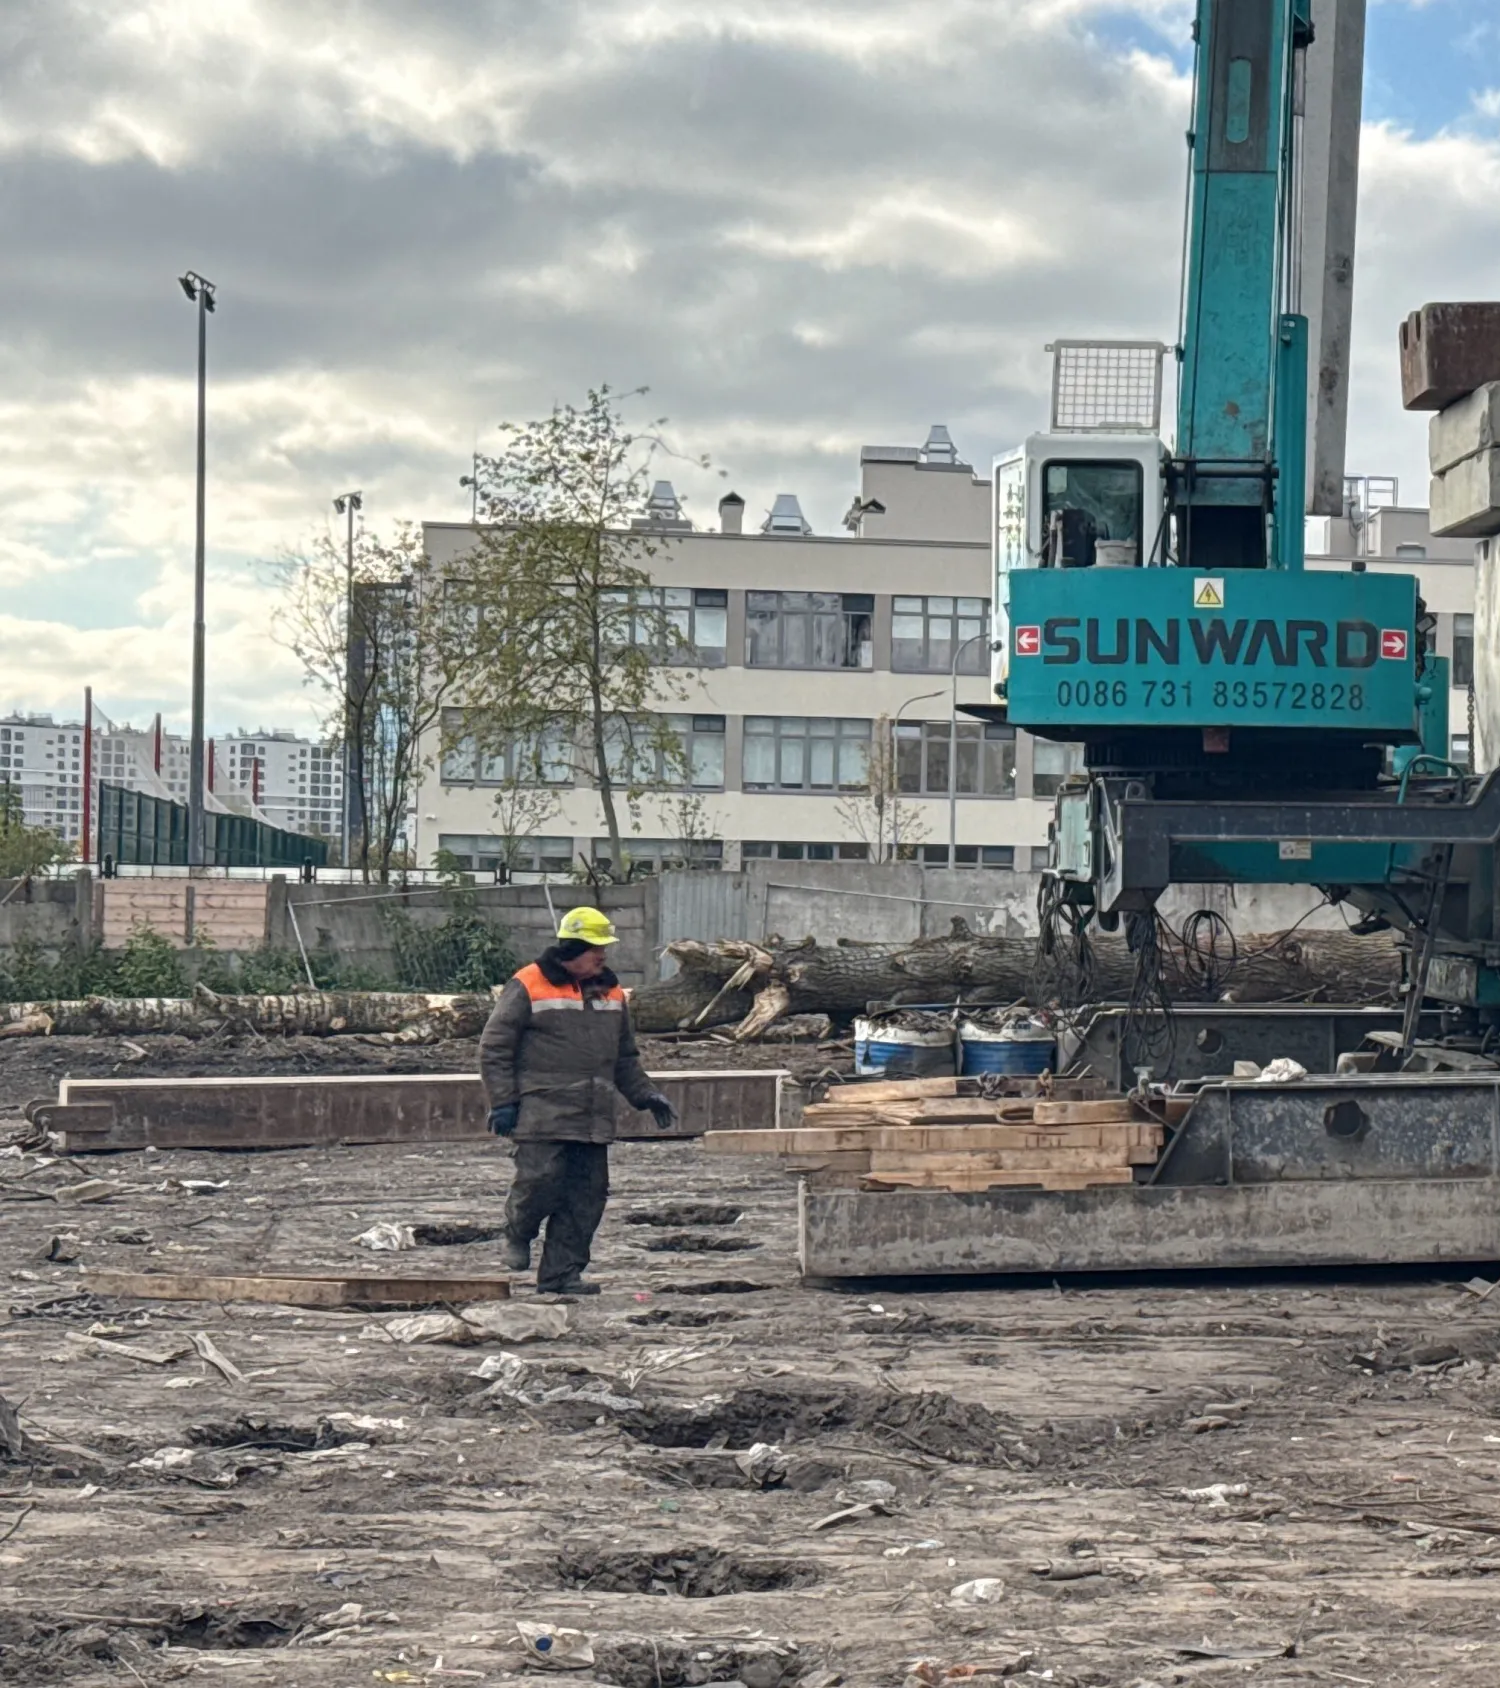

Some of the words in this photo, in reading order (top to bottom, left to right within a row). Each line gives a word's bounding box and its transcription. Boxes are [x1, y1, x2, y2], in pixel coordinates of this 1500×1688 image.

[1043, 617, 1379, 668] SUNWARD
[1057, 680, 1127, 707] 0086
[1143, 680, 1193, 707] 731
[1213, 681, 1364, 711] 83572828
